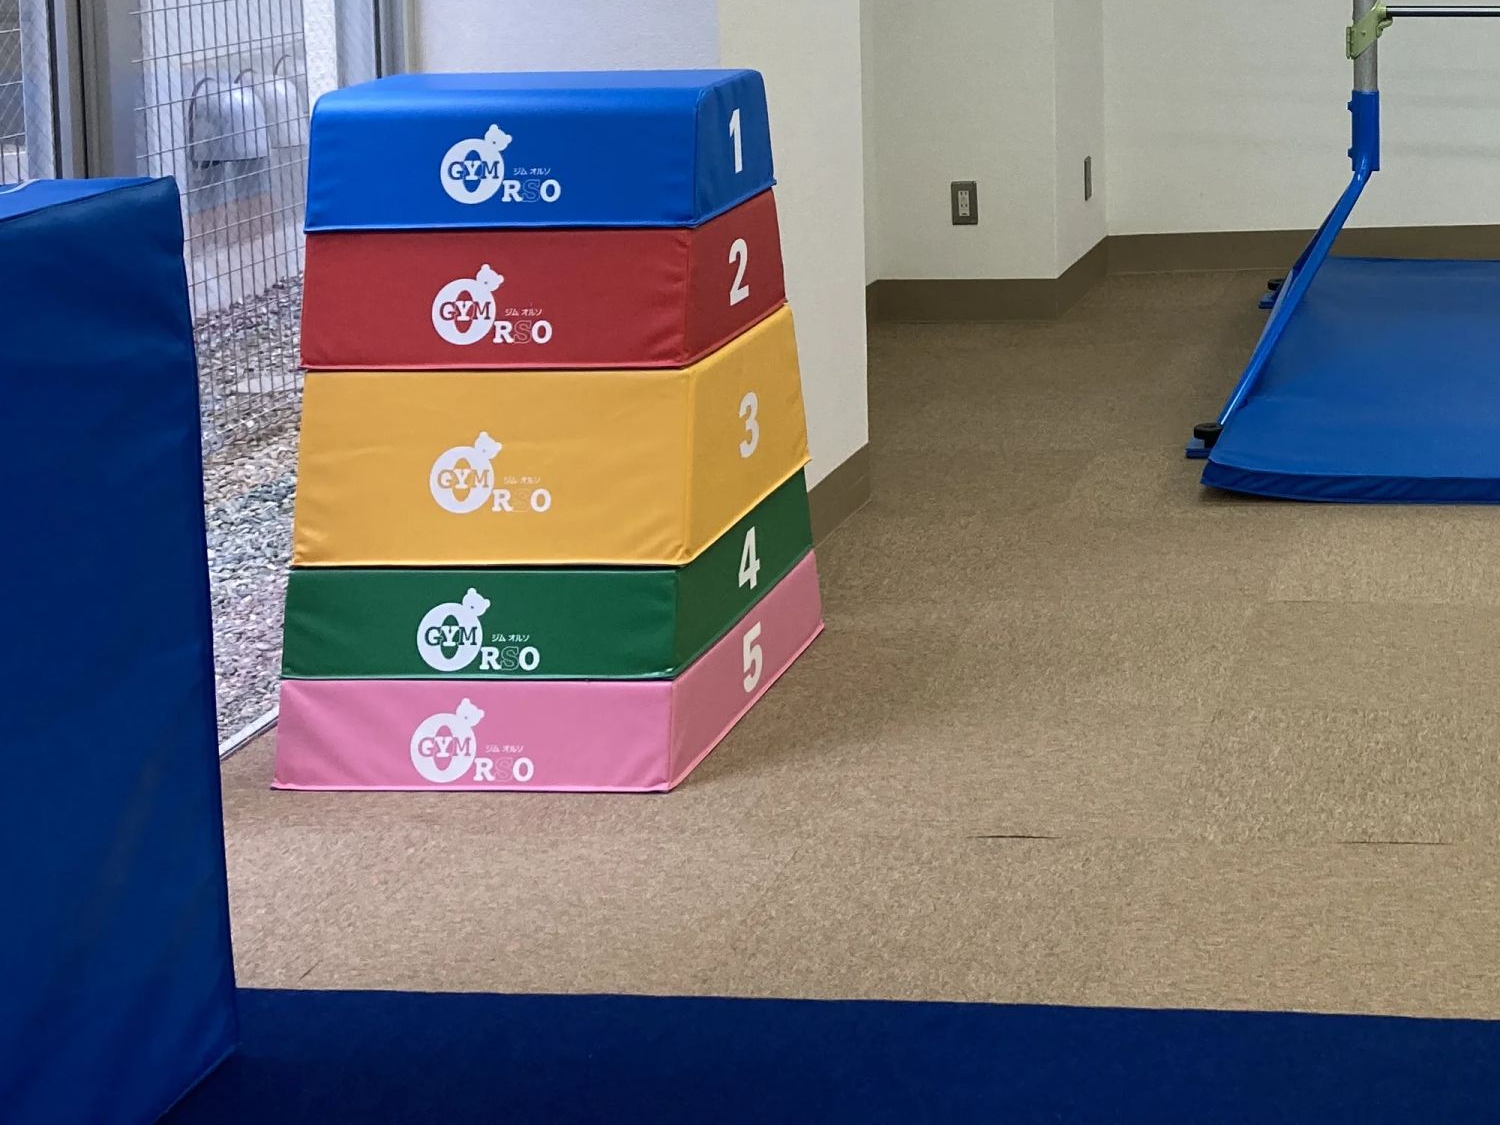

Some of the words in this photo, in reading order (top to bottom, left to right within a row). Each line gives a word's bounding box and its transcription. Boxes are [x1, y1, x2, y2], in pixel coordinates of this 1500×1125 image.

[729, 108, 743, 174] 1
[447, 160, 500, 180] GYM
[728, 238, 749, 306] 2
[440, 300, 491, 321] GYM
[739, 392, 759, 458] 3
[437, 468, 490, 489] GYM
[738, 526, 760, 590] 4
[424, 625, 477, 647] GYM
[743, 621, 763, 693] 5
[418, 736, 471, 757] GYM
